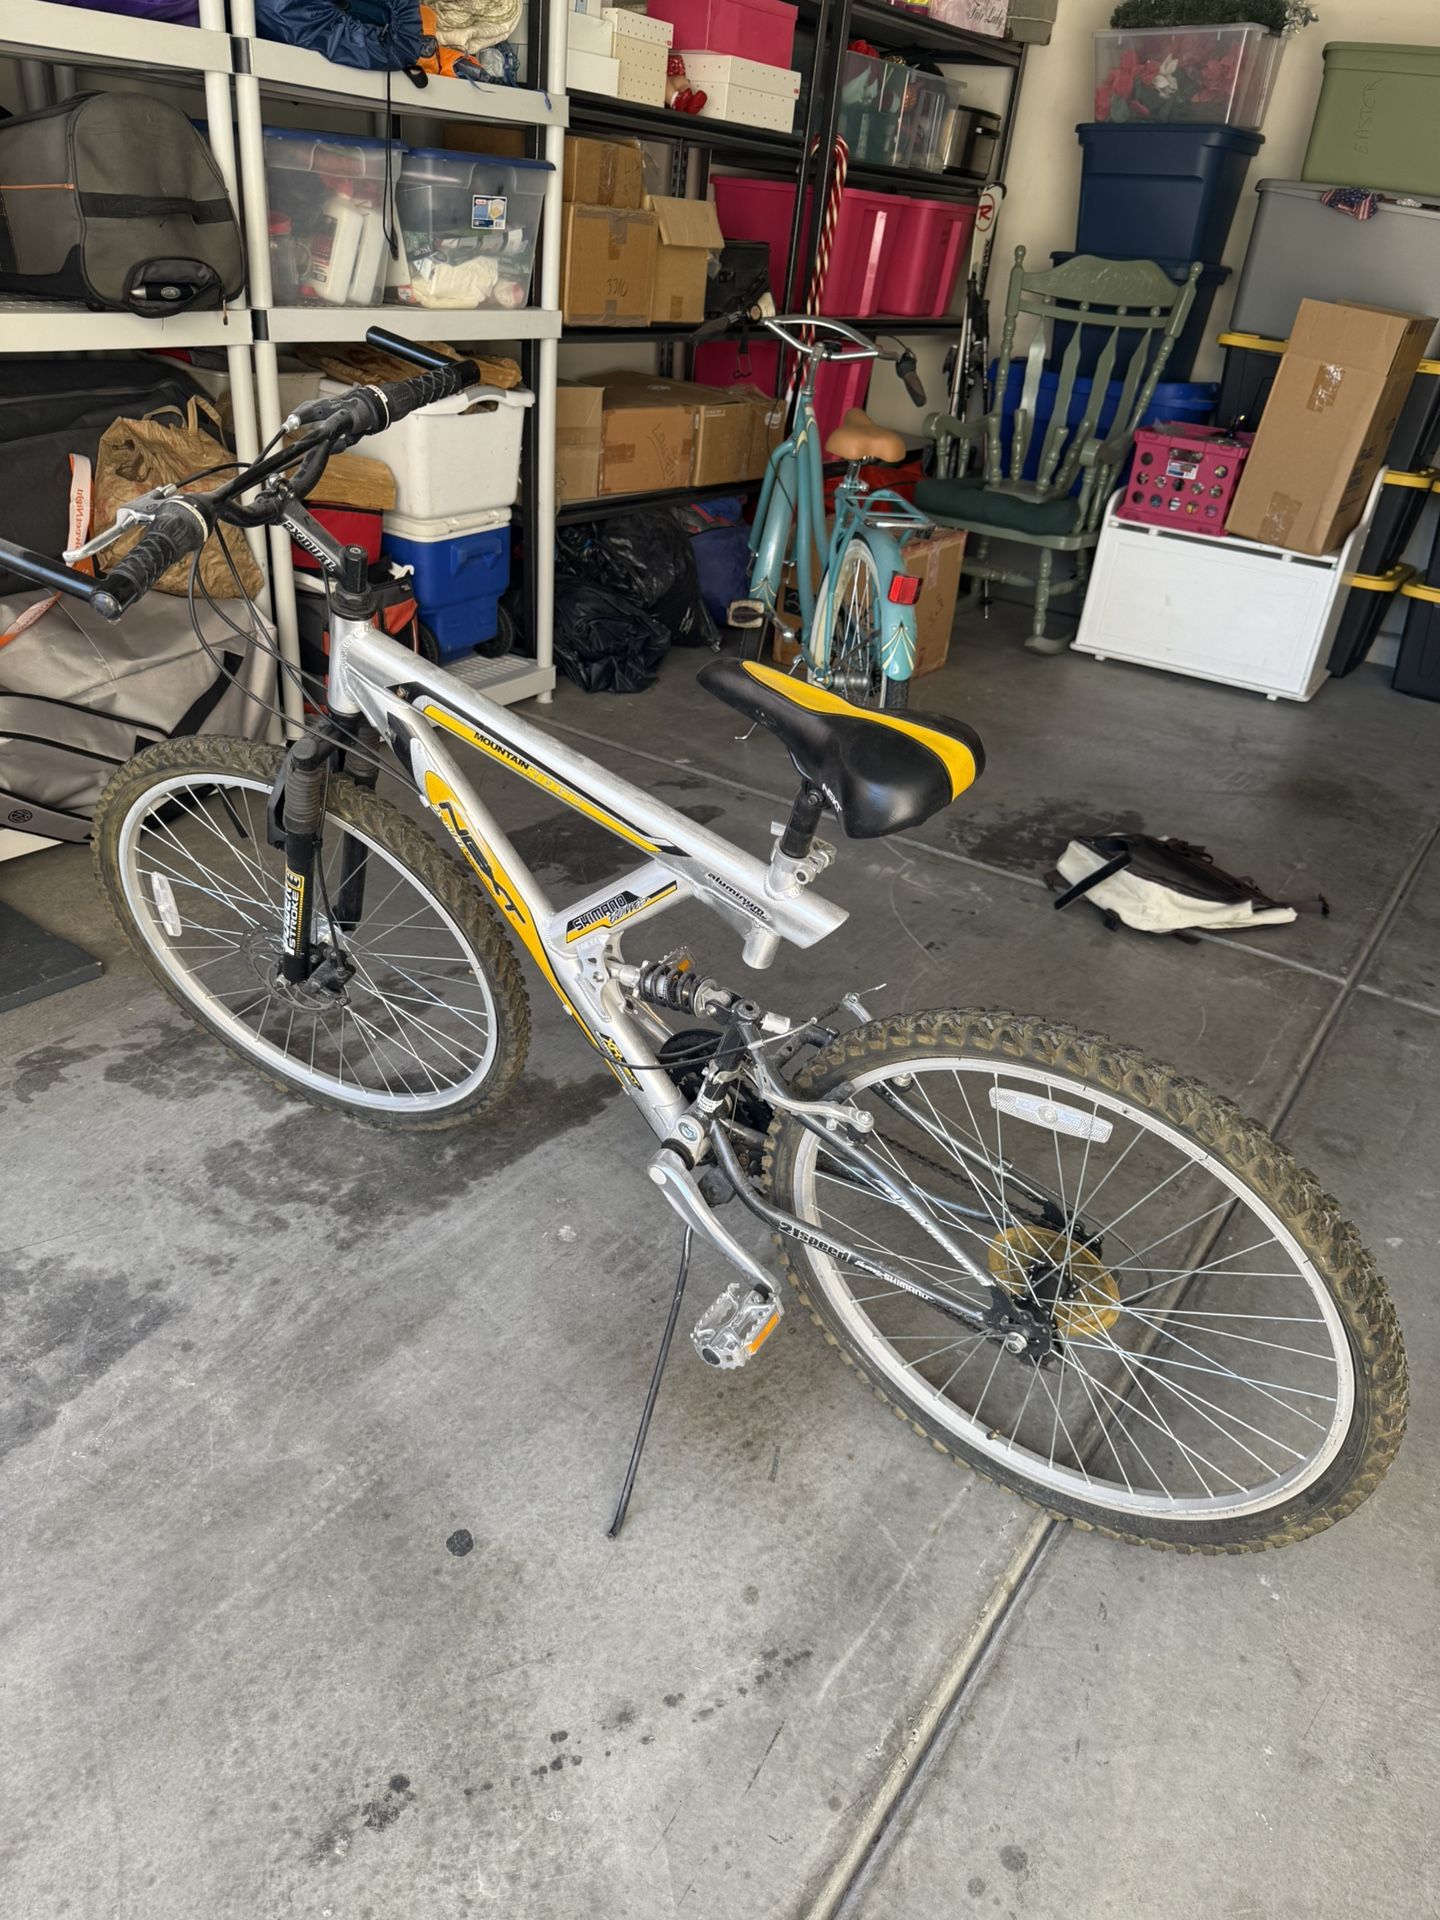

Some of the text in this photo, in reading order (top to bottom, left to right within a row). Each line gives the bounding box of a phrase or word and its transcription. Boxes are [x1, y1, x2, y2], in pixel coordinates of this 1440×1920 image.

[1353, 78, 1384, 155] EASTER
[978, 205, 993, 220] R
[474, 731, 530, 770] MOUNTAIN
[572, 894, 628, 931] SHIMANO
[707, 872, 765, 915] aluminum
[288, 890, 300, 949] STROKE
